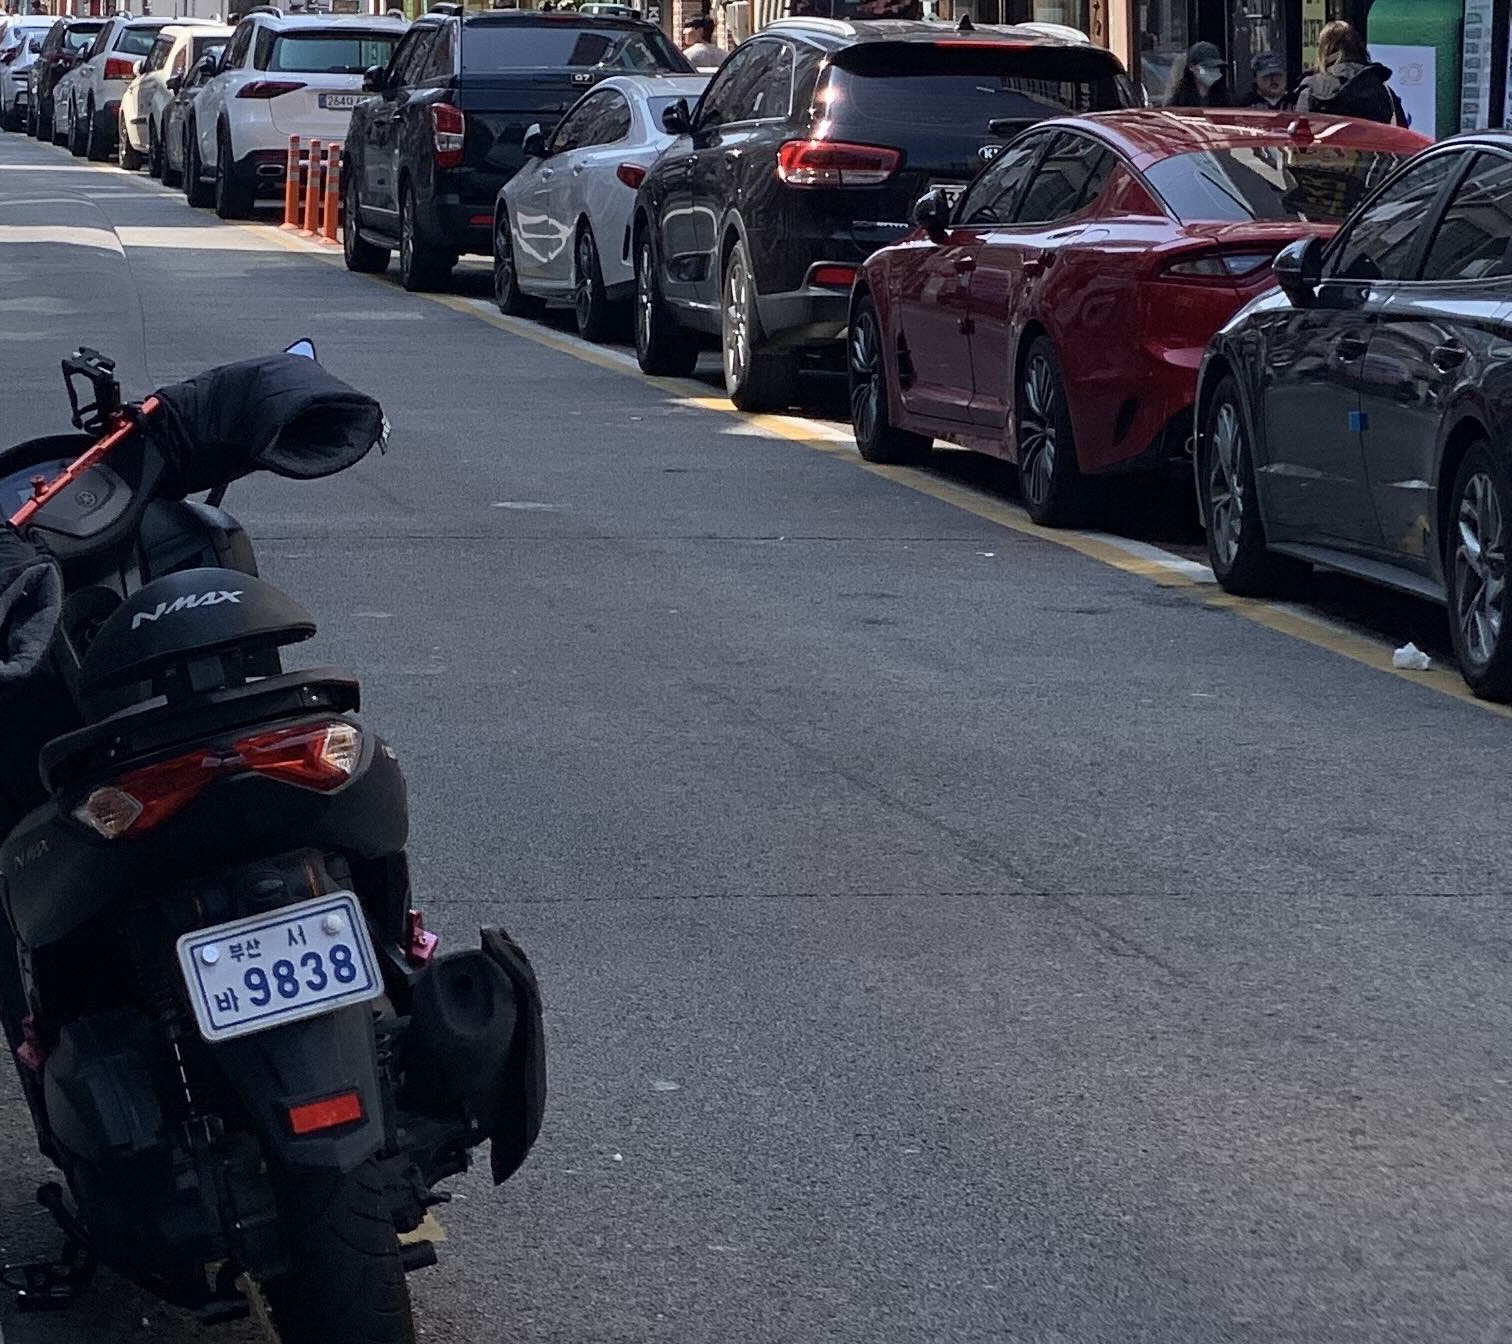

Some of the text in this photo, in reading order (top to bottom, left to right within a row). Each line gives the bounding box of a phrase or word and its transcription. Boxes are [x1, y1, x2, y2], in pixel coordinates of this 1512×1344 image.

[131, 589, 244, 630] NMAX
[229, 924, 308, 962] 부산 서
[215, 943, 358, 1013] 바 9838
